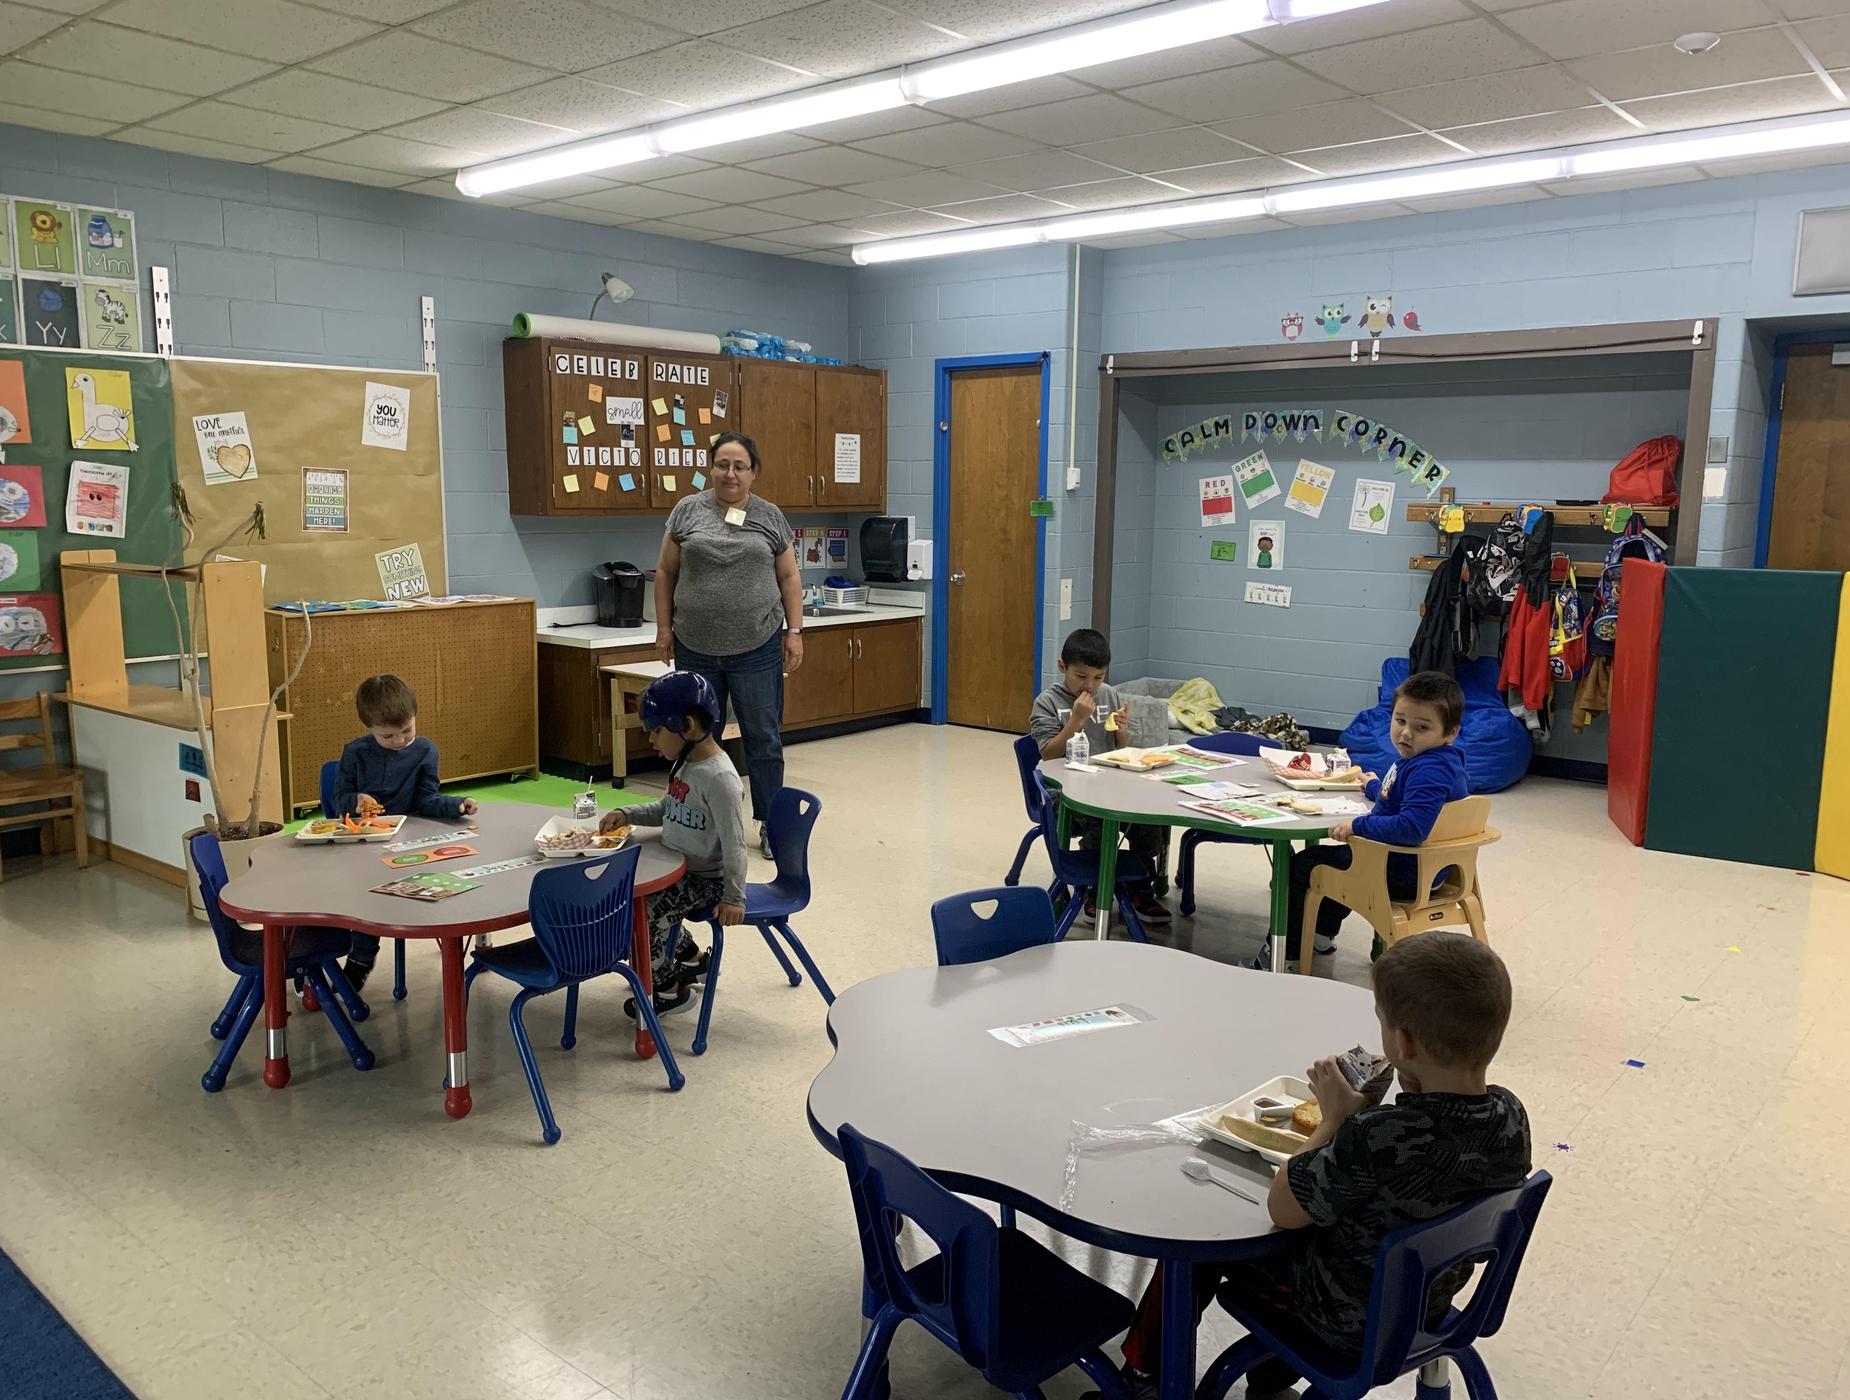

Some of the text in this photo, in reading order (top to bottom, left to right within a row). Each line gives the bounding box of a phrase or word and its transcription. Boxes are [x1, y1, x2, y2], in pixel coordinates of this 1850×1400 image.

[86, 251, 130, 274] Mm
[35, 320, 67, 346] Yy
[96, 324, 132, 351] Zz
[376, 404, 397, 417] YOU
[607, 401, 643, 421] small
[195, 416, 222, 432] LOVE
[203, 426, 246, 439] one another
[1164, 418, 1230, 453] CALM
[1235, 452, 1264, 473] GREEN
[1299, 462, 1334, 480] YELLOW
[1205, 479, 1226, 489] RED
[309, 496, 340, 505] THINGS
[308, 507, 341, 516] HAPPEN
[380, 548, 414, 573] TRY
[387, 575, 425, 601] NEW
